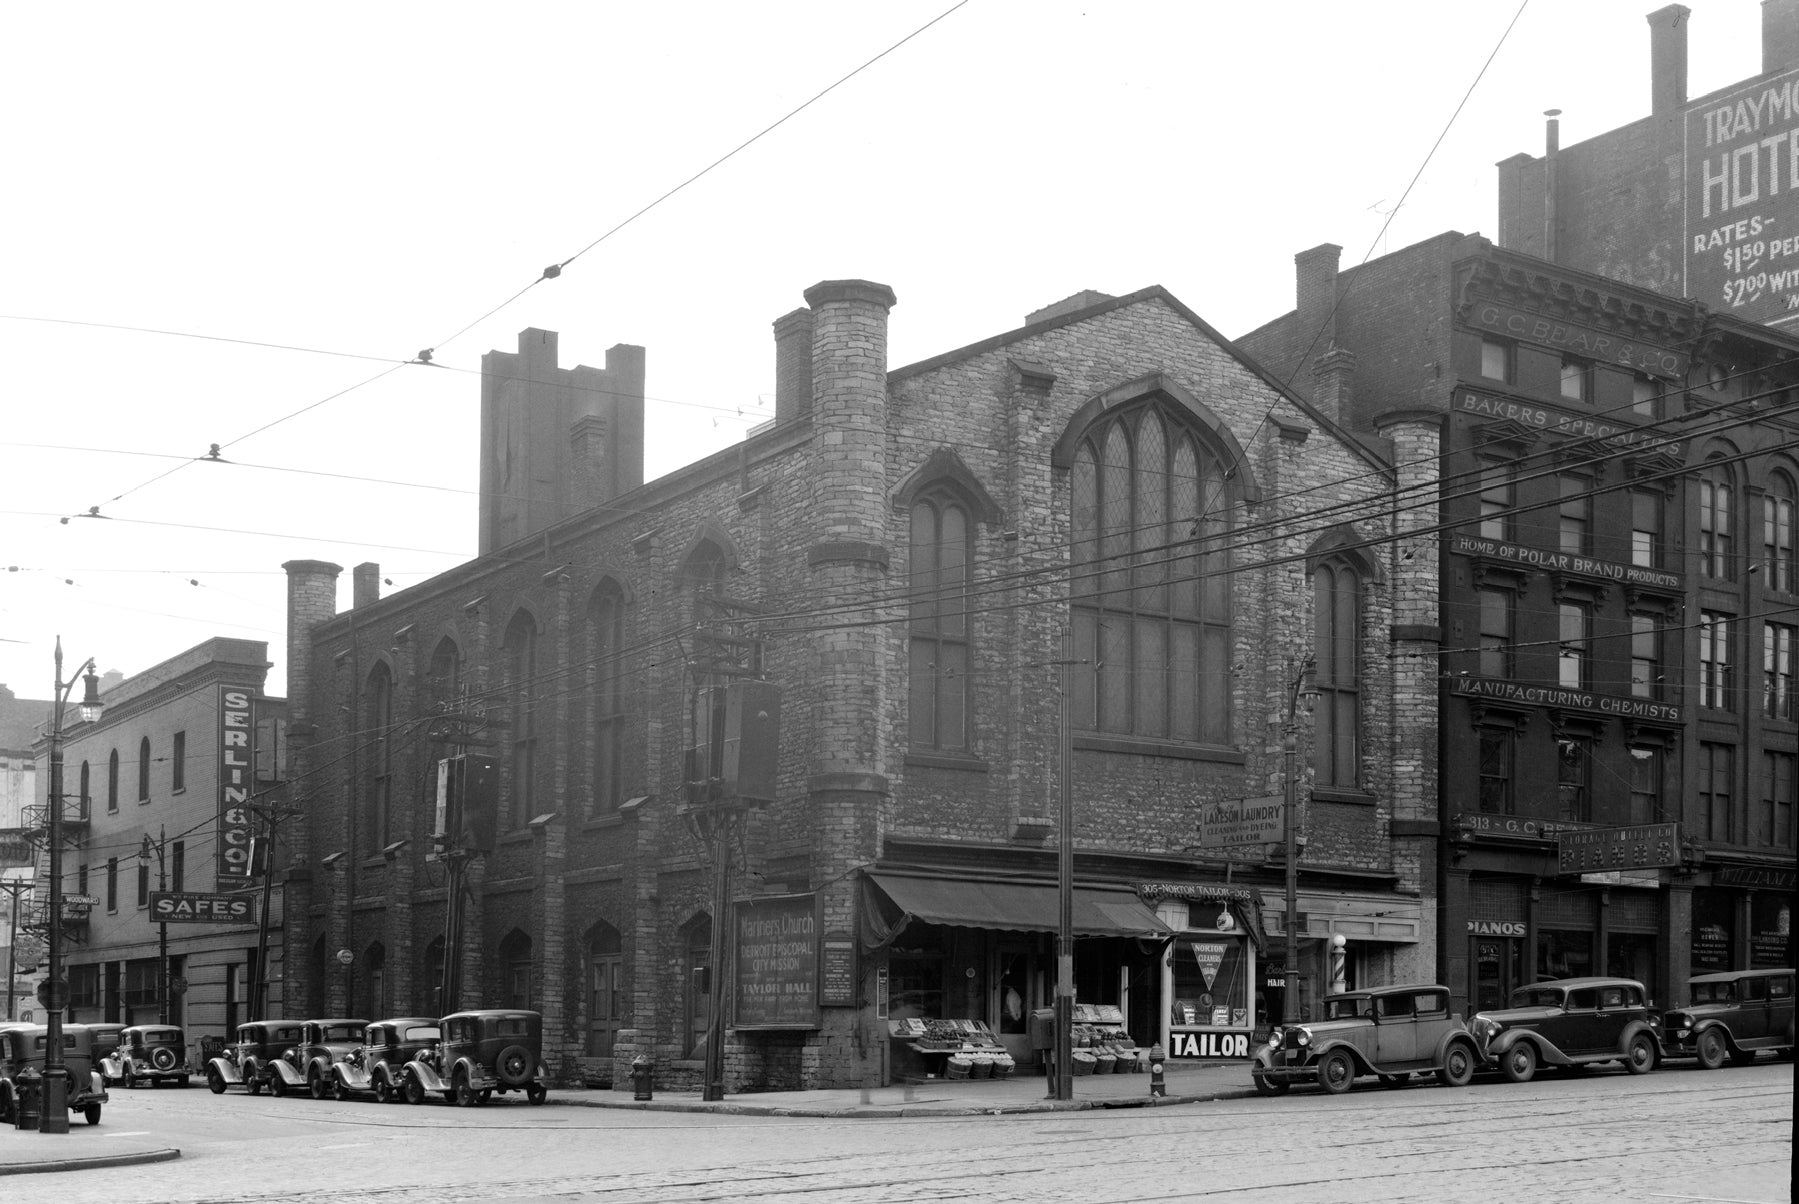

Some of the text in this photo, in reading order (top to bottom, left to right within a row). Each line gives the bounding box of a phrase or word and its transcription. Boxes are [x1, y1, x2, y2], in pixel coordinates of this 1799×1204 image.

[1532, 321, 1611, 356] BEAR
[1618, 344, 1633, 362] &
[1463, 395, 1548, 425] BAKERS
[1460, 538, 1679, 588] HOME OF POLAR BRAND PRODUCTS
[1458, 679, 1679, 720] MANUFACTURING CHEMISTS
[224, 692, 249, 803] SERLIN
[1241, 805, 1281, 822] LAUNDRY
[1207, 826, 1238, 836] CLEANING
[1250, 821, 1278, 832] DYEING
[1222, 833, 1261, 844] TAILOR
[1561, 841, 1672, 868] PIANOS
[157, 899, 248, 915] SAFES
[782, 911, 815, 934] Church
[741, 944, 773, 958] DETROIT
[773, 942, 813, 956] EPISCOPAL
[1195, 944, 1224, 953] NORTON
[752, 957, 800, 972] CITY MISSION
[743, 983, 780, 994] TAYLOR
[785, 982, 813, 993] HALL
[1267, 978, 1286, 988] HAIR
[1171, 1033, 1248, 1056] TAILOR
